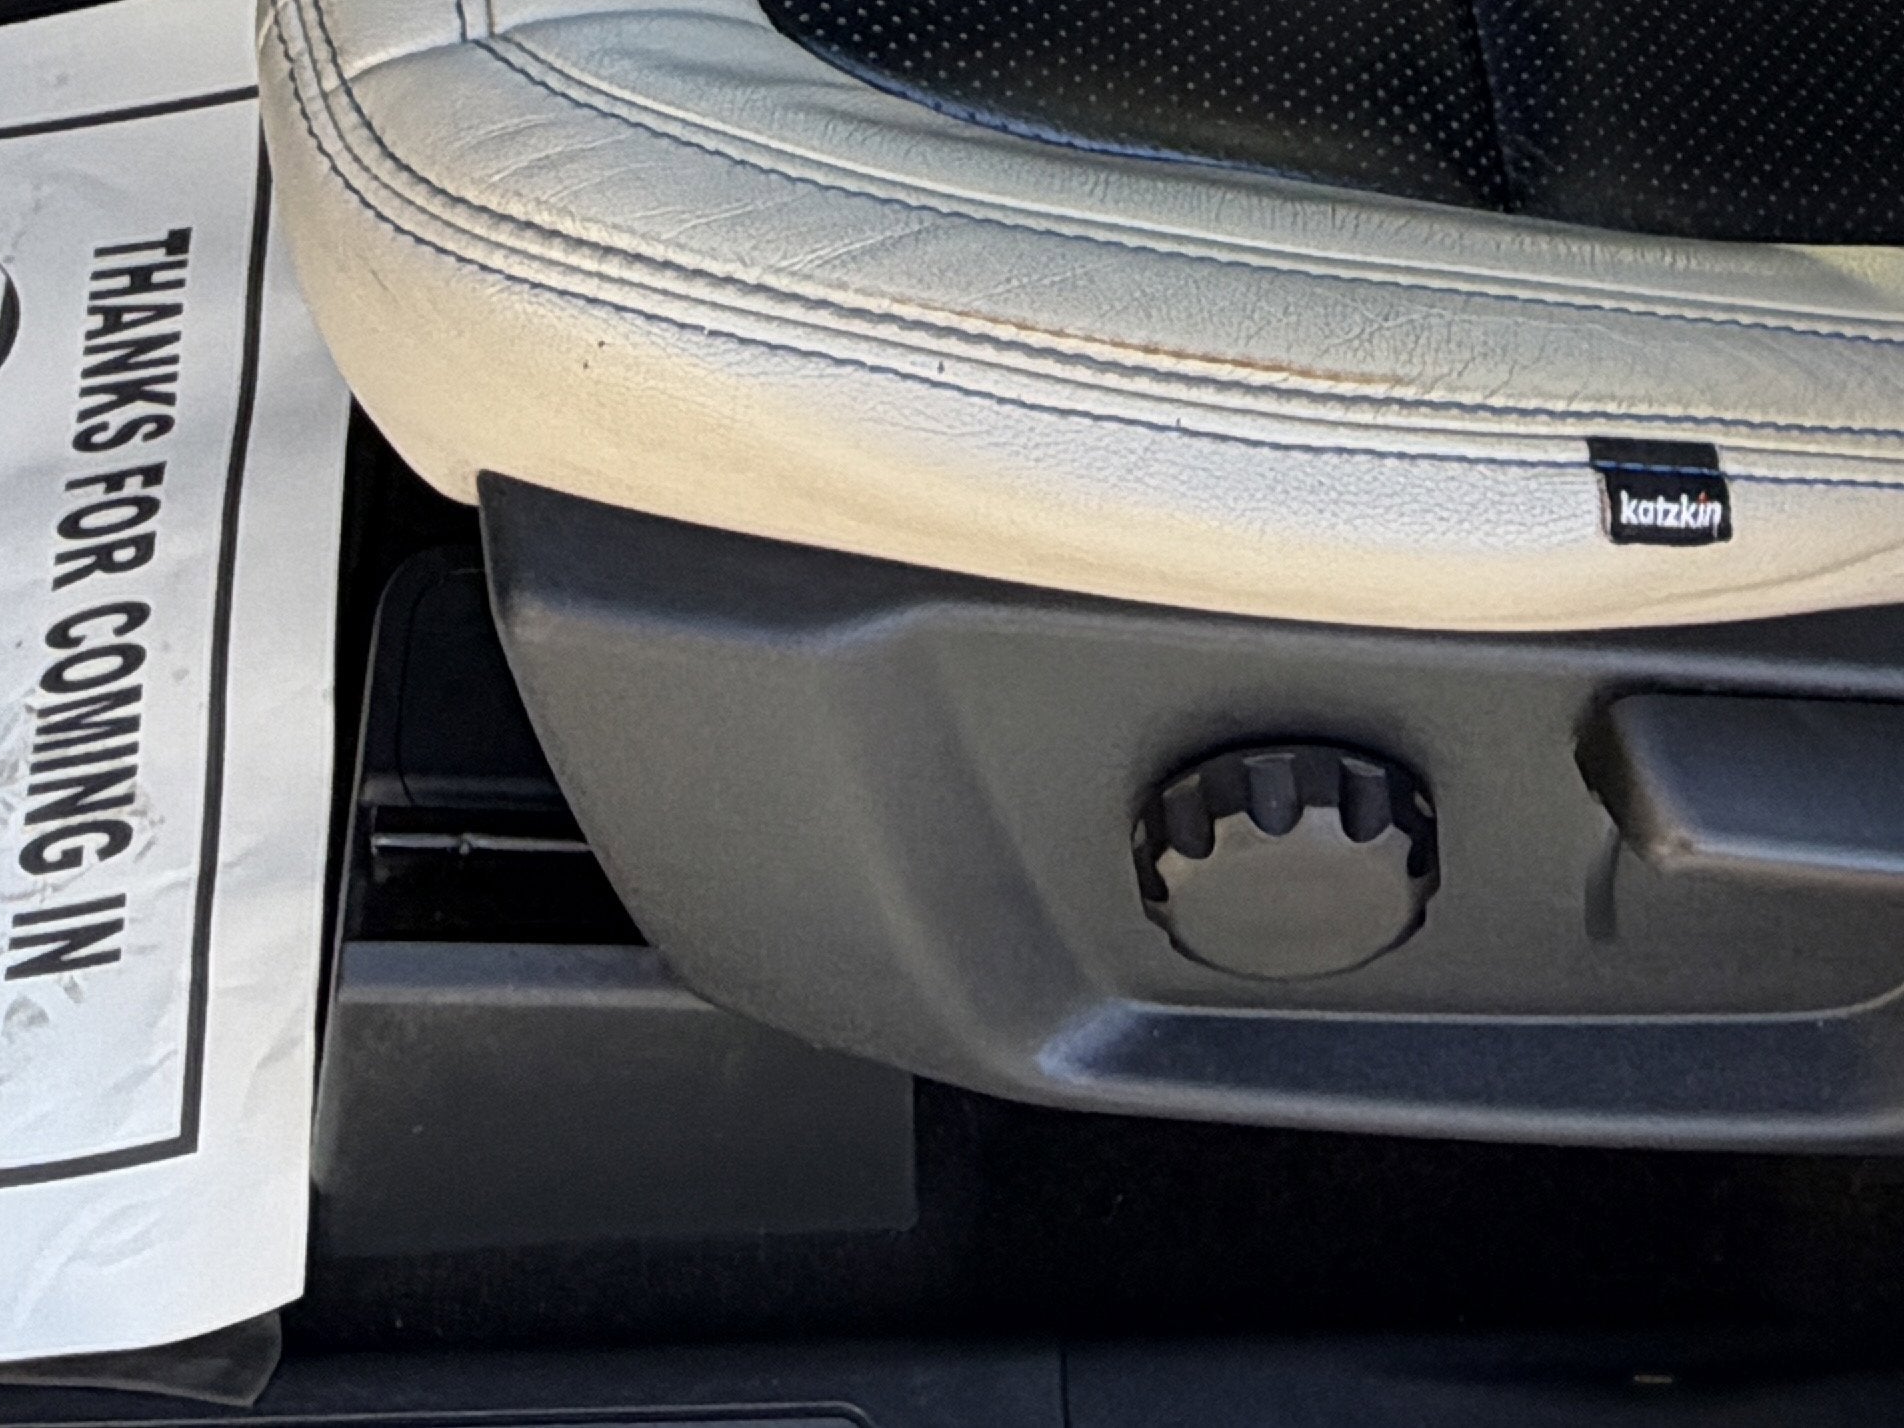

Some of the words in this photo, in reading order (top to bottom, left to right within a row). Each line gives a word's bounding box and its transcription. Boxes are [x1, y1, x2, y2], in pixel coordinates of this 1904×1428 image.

[72, 227, 193, 454] THANKS
[52, 461, 167, 591] FOR
[1620, 490, 1723, 531] katzkin
[18, 600, 151, 875] COMING
[5, 893, 126, 980] IN
